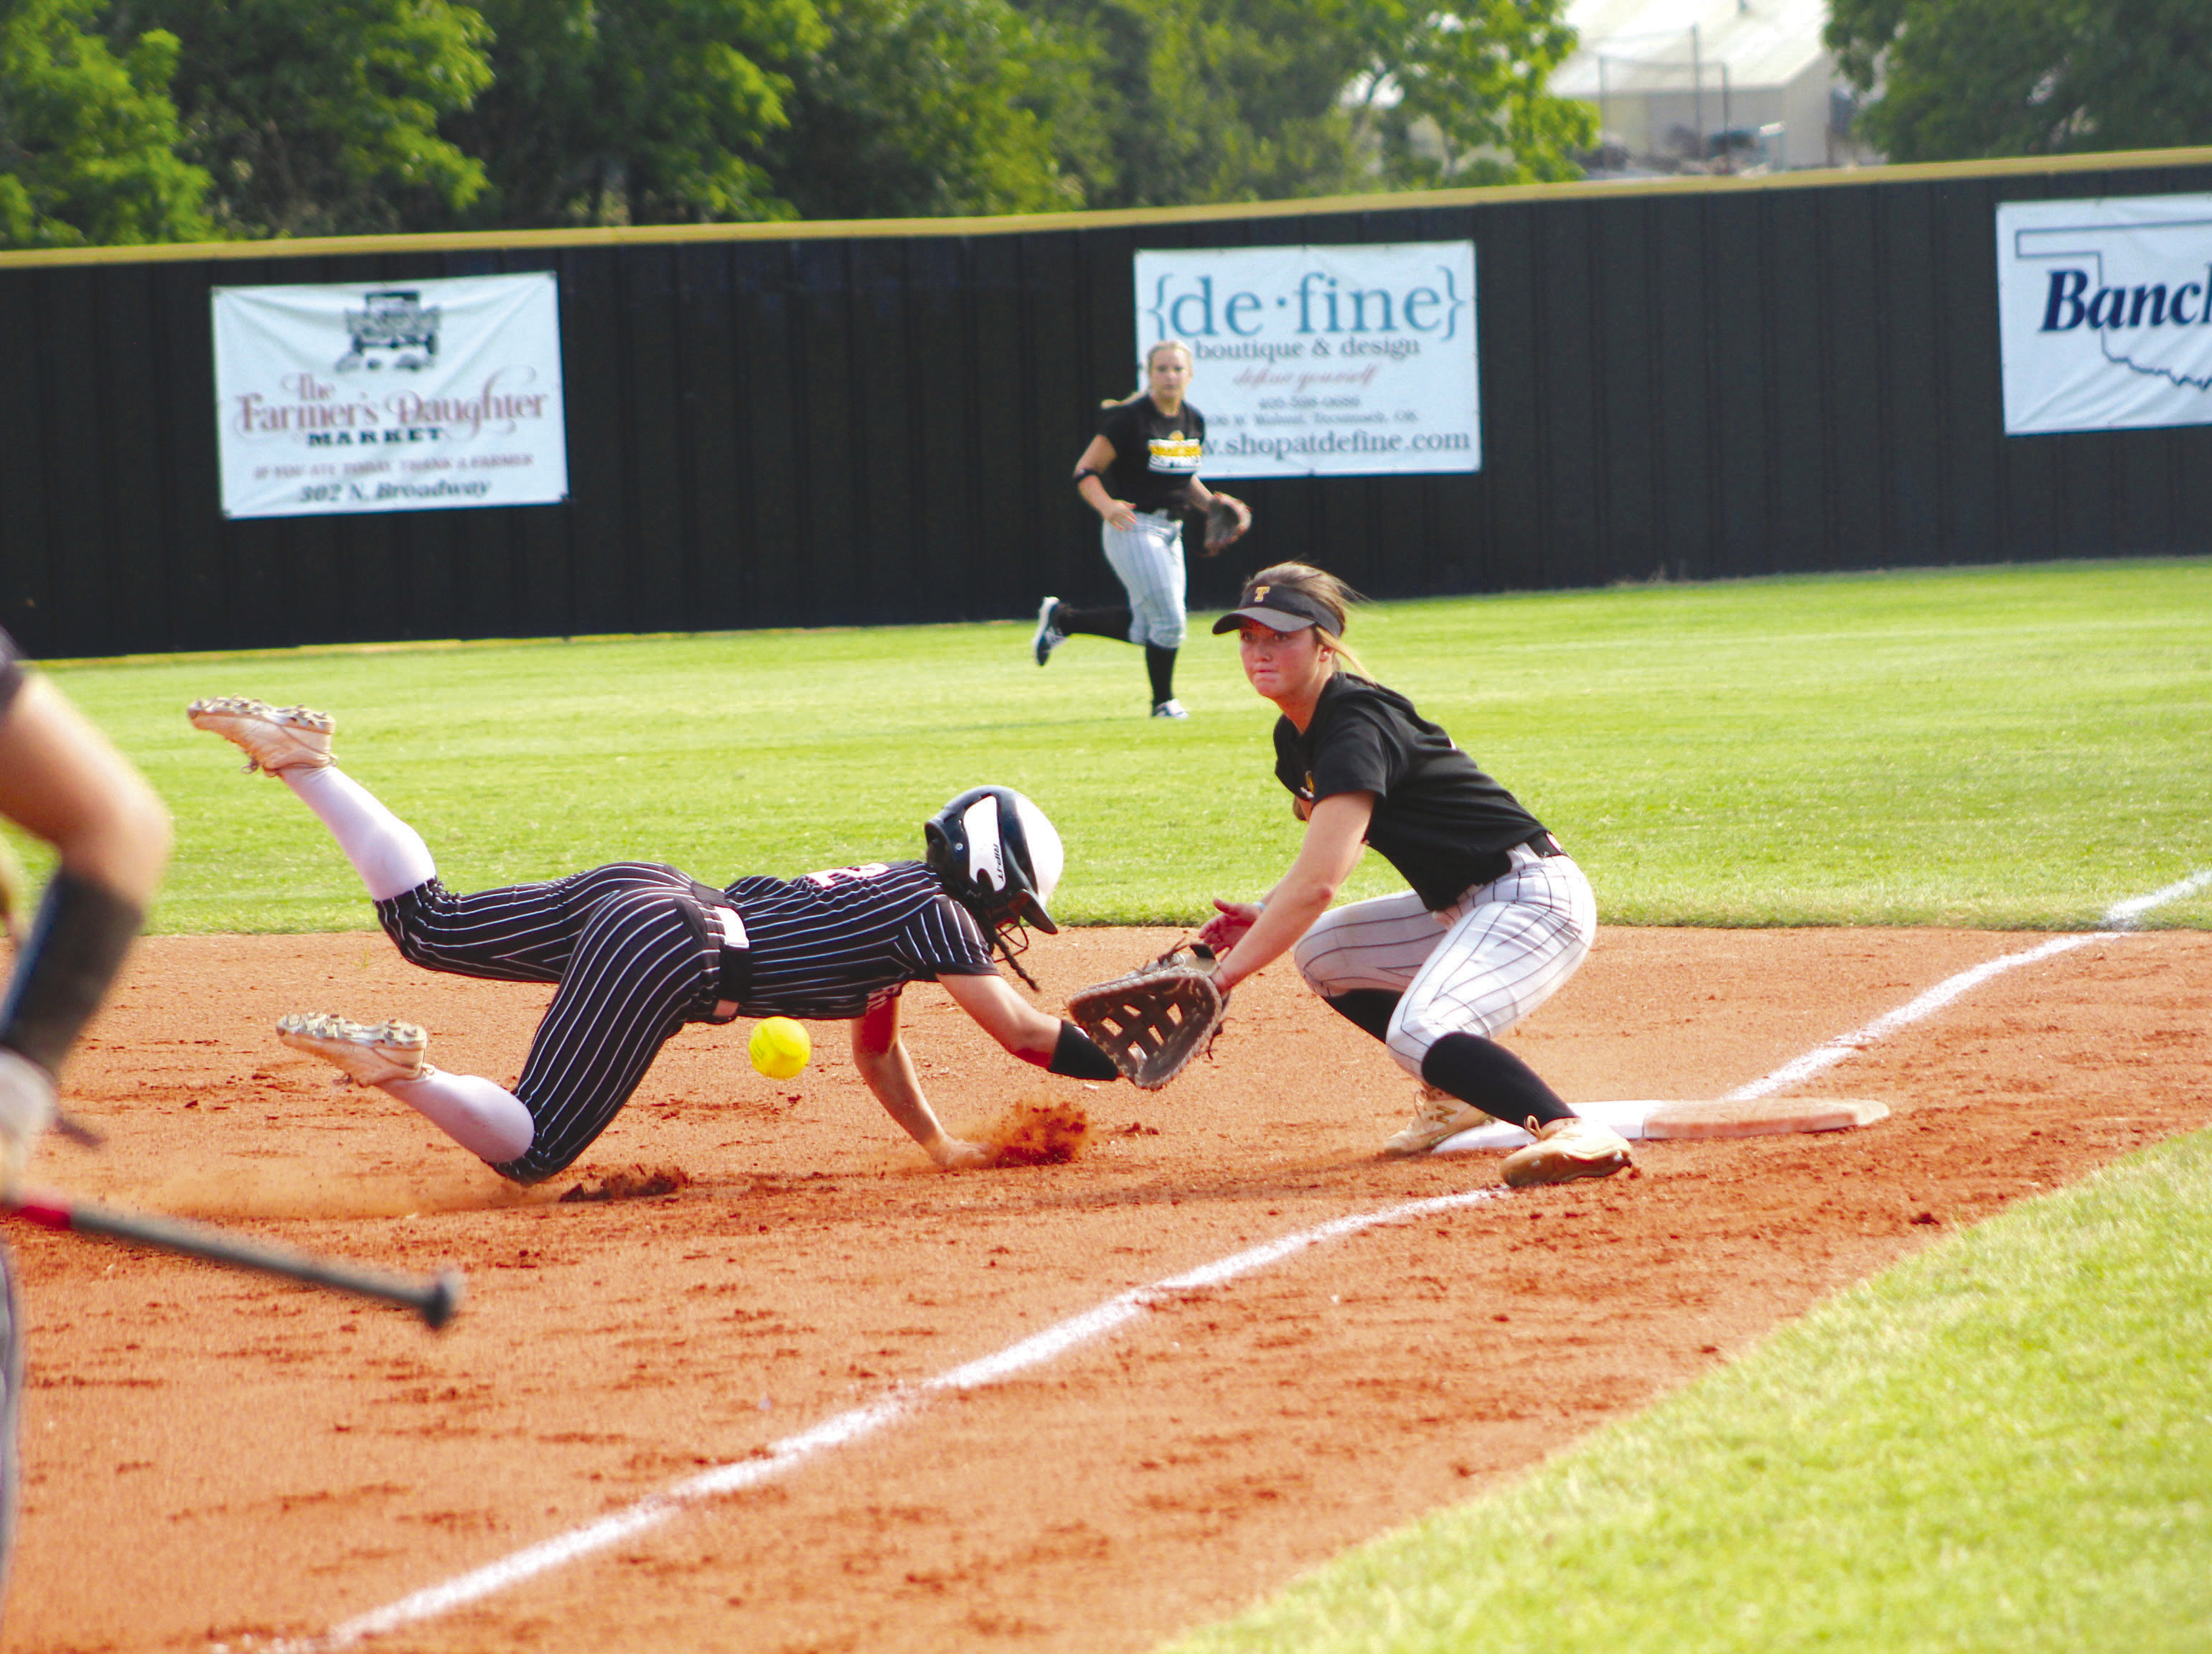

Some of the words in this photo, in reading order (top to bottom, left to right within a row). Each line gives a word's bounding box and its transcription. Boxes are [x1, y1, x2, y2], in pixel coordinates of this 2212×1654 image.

[2038, 261, 2212, 332] Banc
[1194, 337, 1306, 364] boutique
[1311, 336, 1331, 357] &
[1339, 335, 1420, 360] design
[281, 373, 336, 402] The
[234, 391, 379, 439] Farmer's
[385, 365, 548, 442] Daughter
[307, 426, 444, 447] MARKET
[1202, 428, 1471, 460] w.shopatdefine.com
[299, 482, 342, 503] 302
[376, 479, 493, 502] Broadway
[1254, 585, 1270, 602] T
